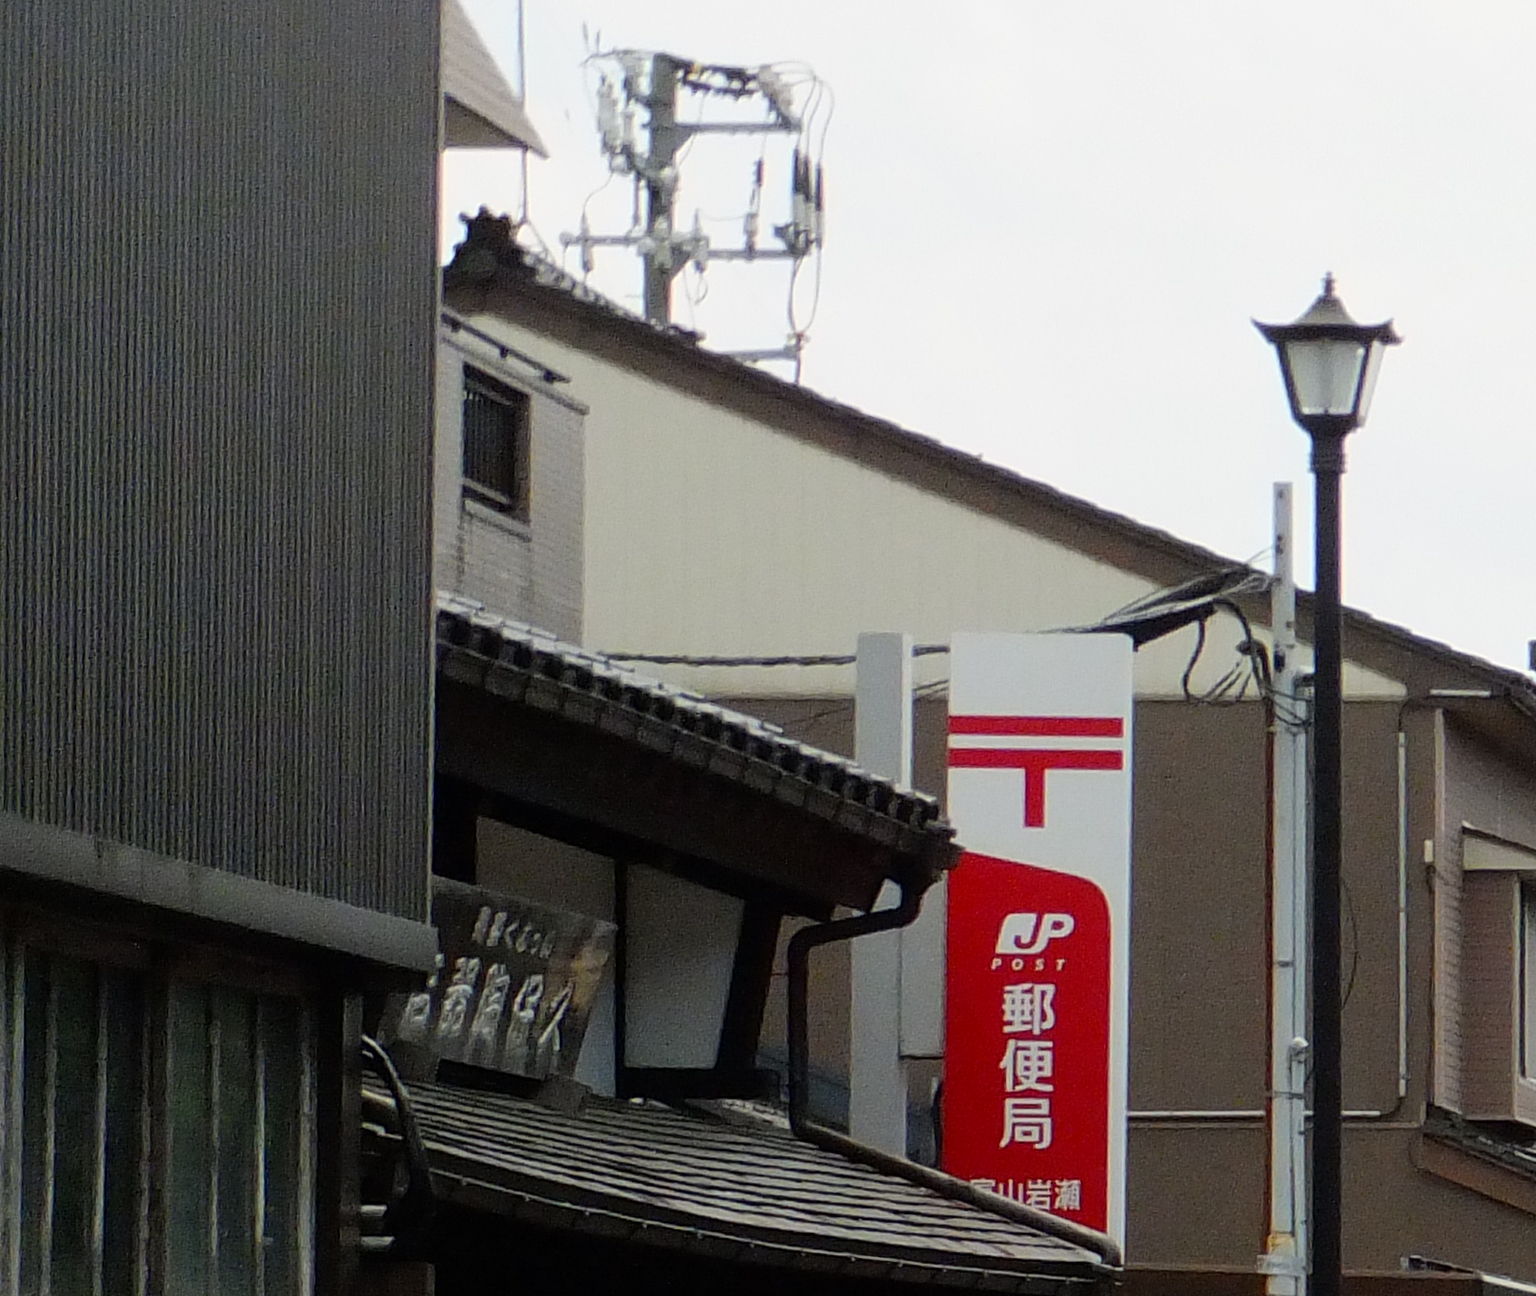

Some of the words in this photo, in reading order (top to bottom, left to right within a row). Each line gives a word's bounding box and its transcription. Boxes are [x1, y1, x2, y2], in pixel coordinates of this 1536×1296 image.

[995, 912, 1075, 955] JP
[990, 957, 1067, 972] POST
[999, 982, 1056, 1150] 郵便局
